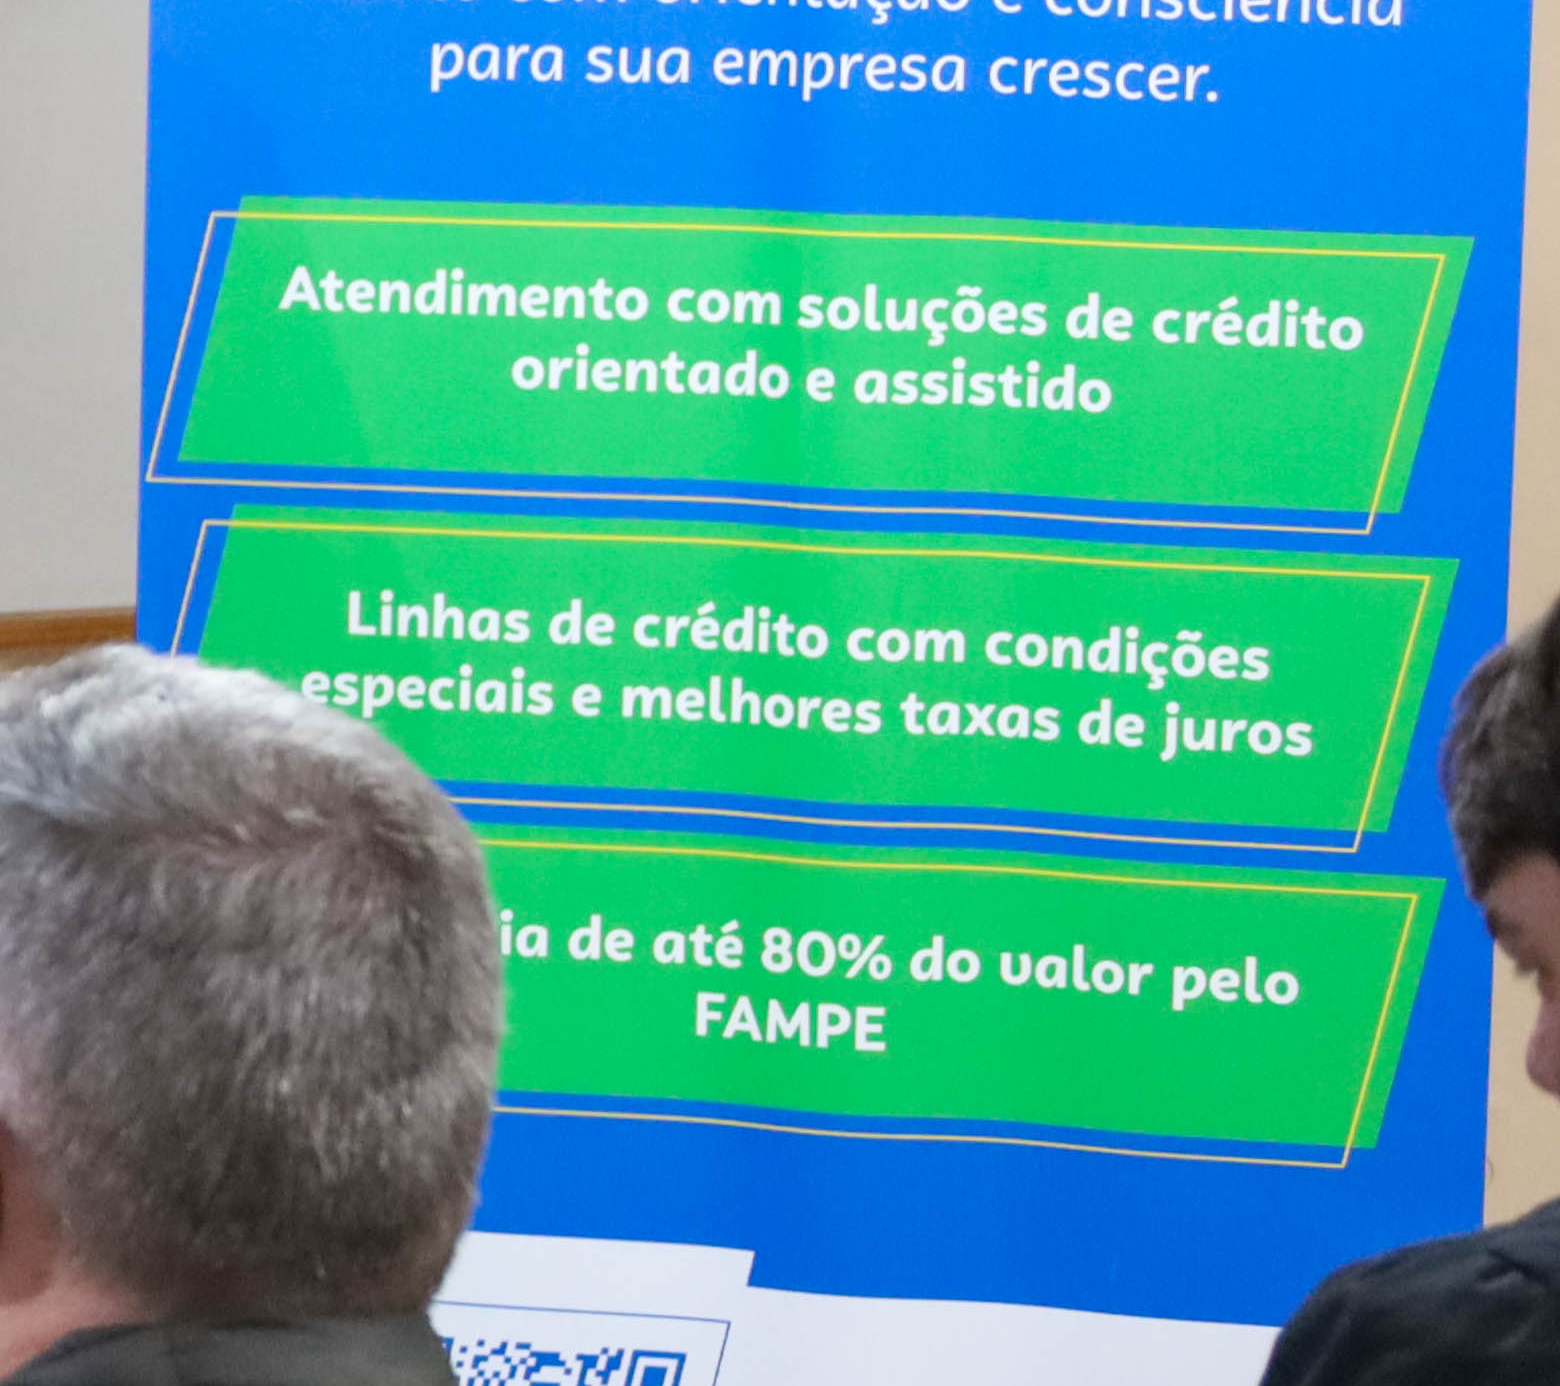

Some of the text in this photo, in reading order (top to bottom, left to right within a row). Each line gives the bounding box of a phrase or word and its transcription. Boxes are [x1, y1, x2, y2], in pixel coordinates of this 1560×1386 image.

[430, 42, 1219, 103] para sua empresa crescer.
[278, 265, 1365, 351] Atendimento com soluções de crédito
[511, 342, 1113, 414] orientado e assistido
[347, 588, 1271, 691] Linhas de crédito com condições
[301, 663, 1314, 762] especiais e melhores taxas de juros
[567, 913, 635, 963] de
[652, 919, 745, 969] até
[760, 926, 893, 981] 80%
[909, 934, 982, 983] do
[999, 943, 1155, 996] valor
[1171, 955, 1301, 1012] pelo
[695, 991, 887, 1053] FAMPE
